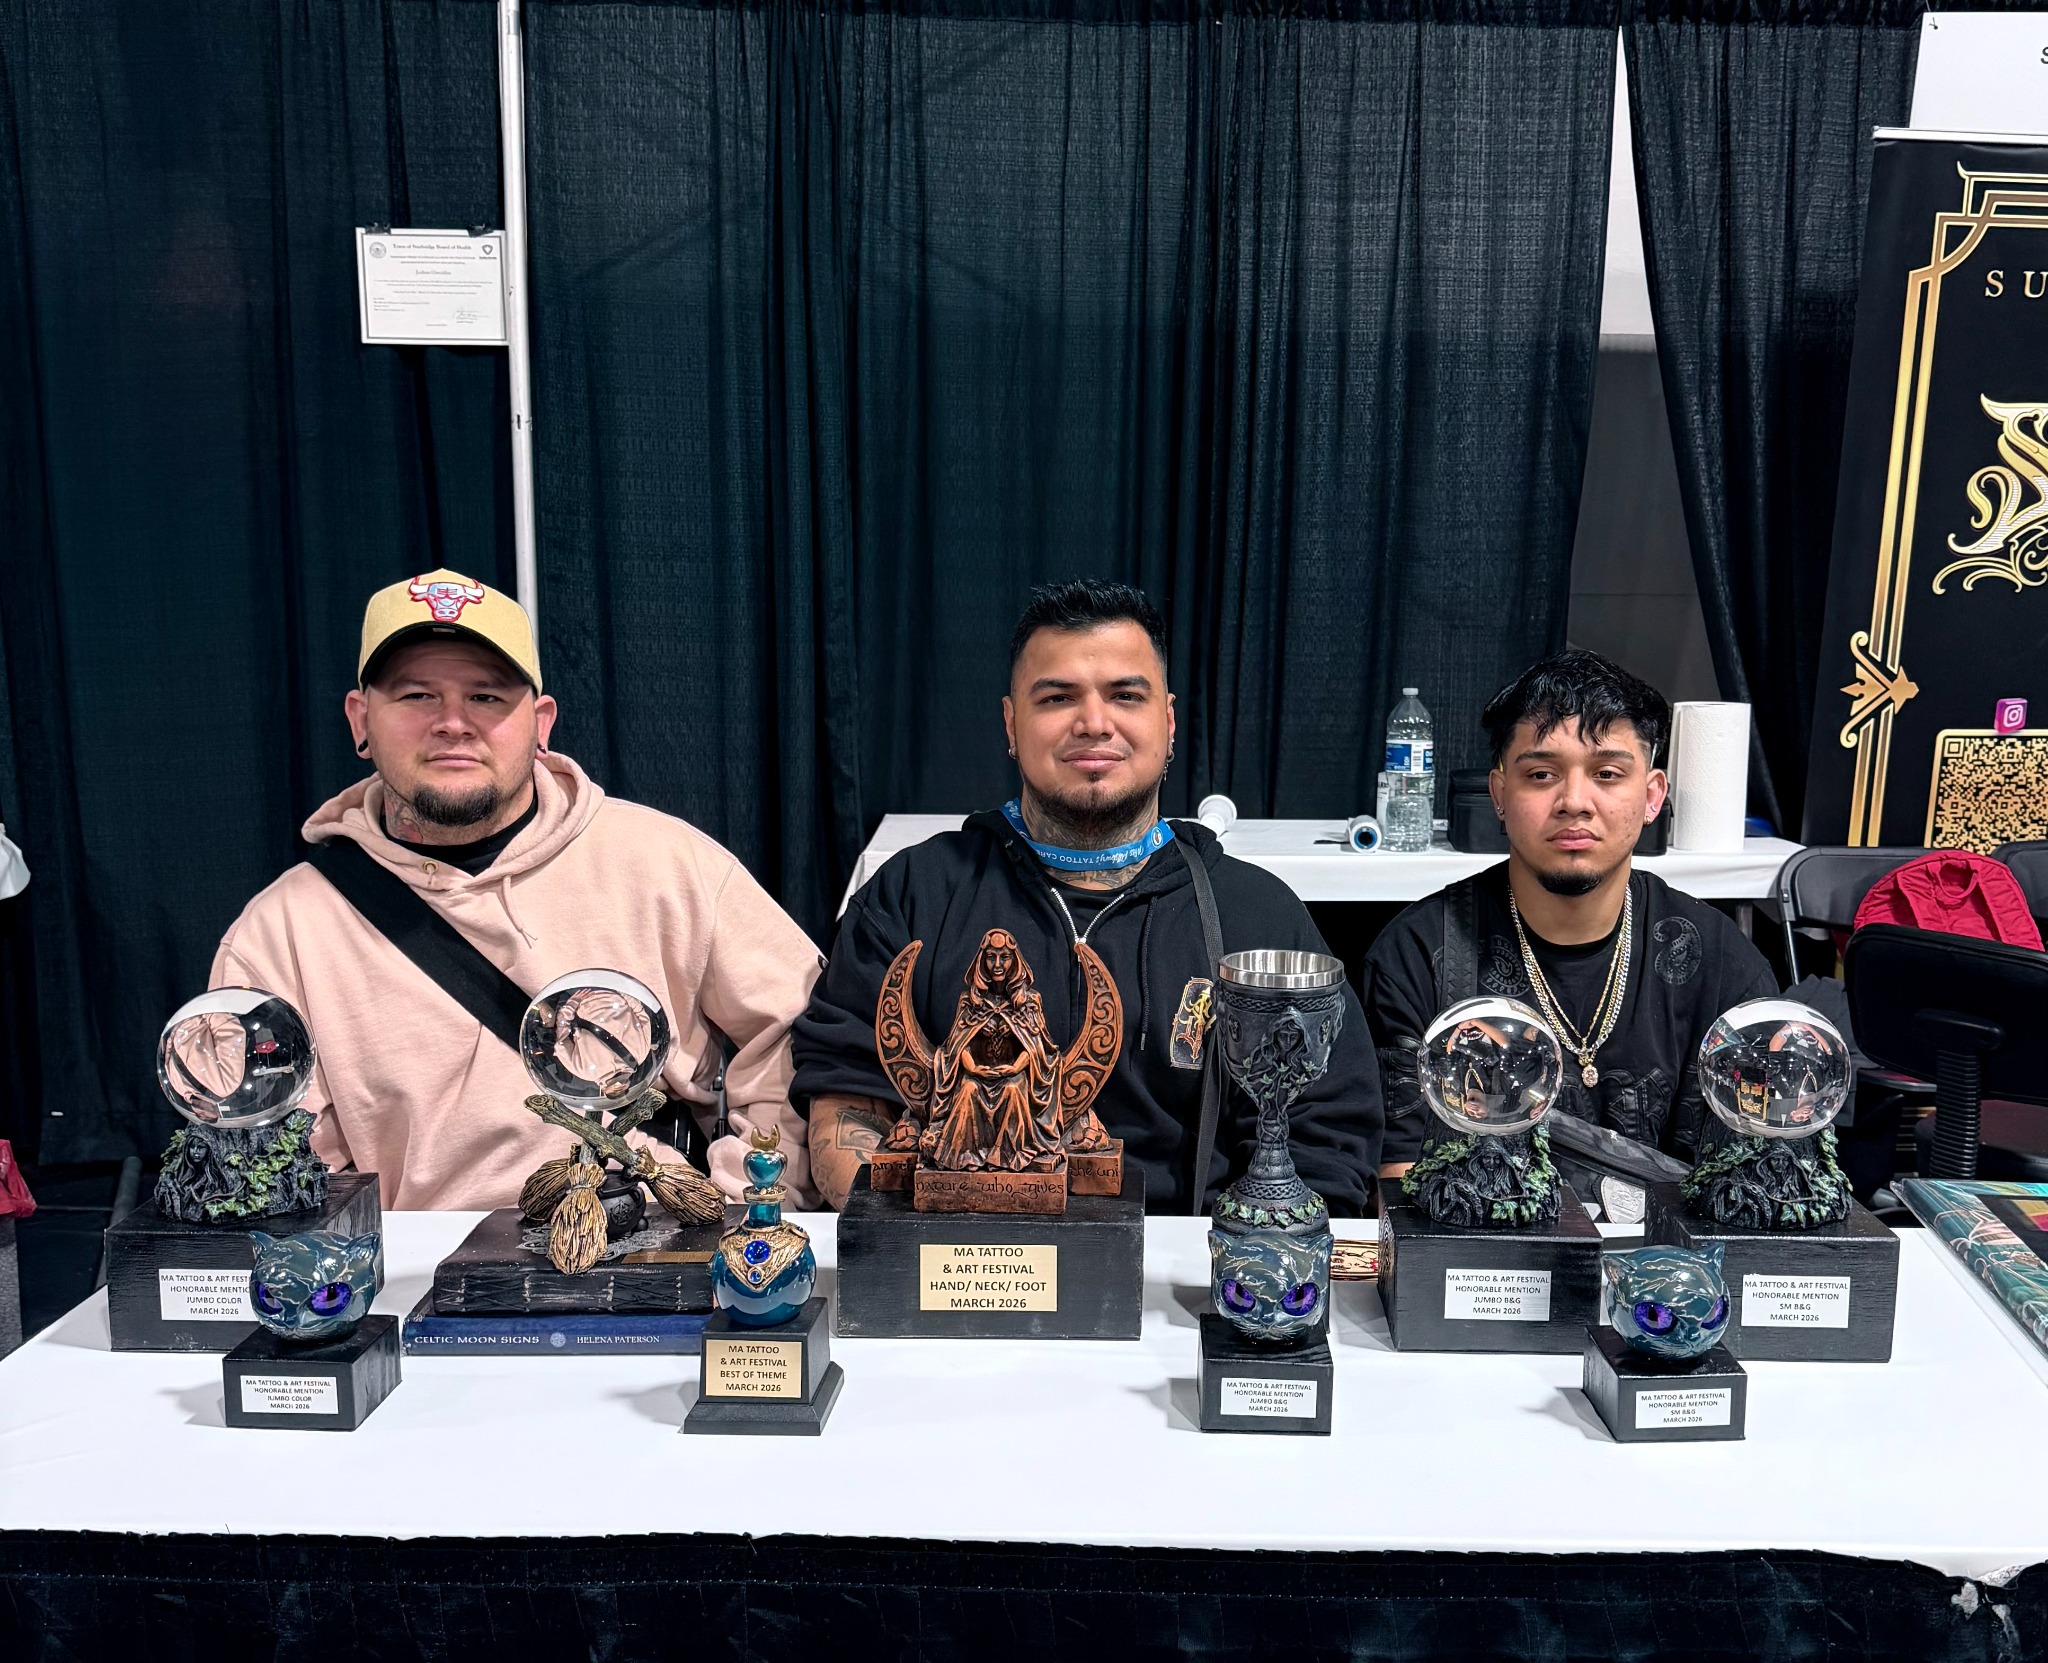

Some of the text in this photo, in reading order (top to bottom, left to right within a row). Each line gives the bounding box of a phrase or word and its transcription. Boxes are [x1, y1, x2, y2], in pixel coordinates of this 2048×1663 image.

[916, 1176, 1064, 1199] nature who gives
[954, 1248, 1024, 1257] MA TATTOO
[943, 1264, 1034, 1274] & ART FESTIVAL
[930, 1281, 1047, 1292] HAND/ NECK/ FOOT
[951, 1298, 1026, 1308] MARCH 2026
[615, 1336, 660, 1344] PATERSON
